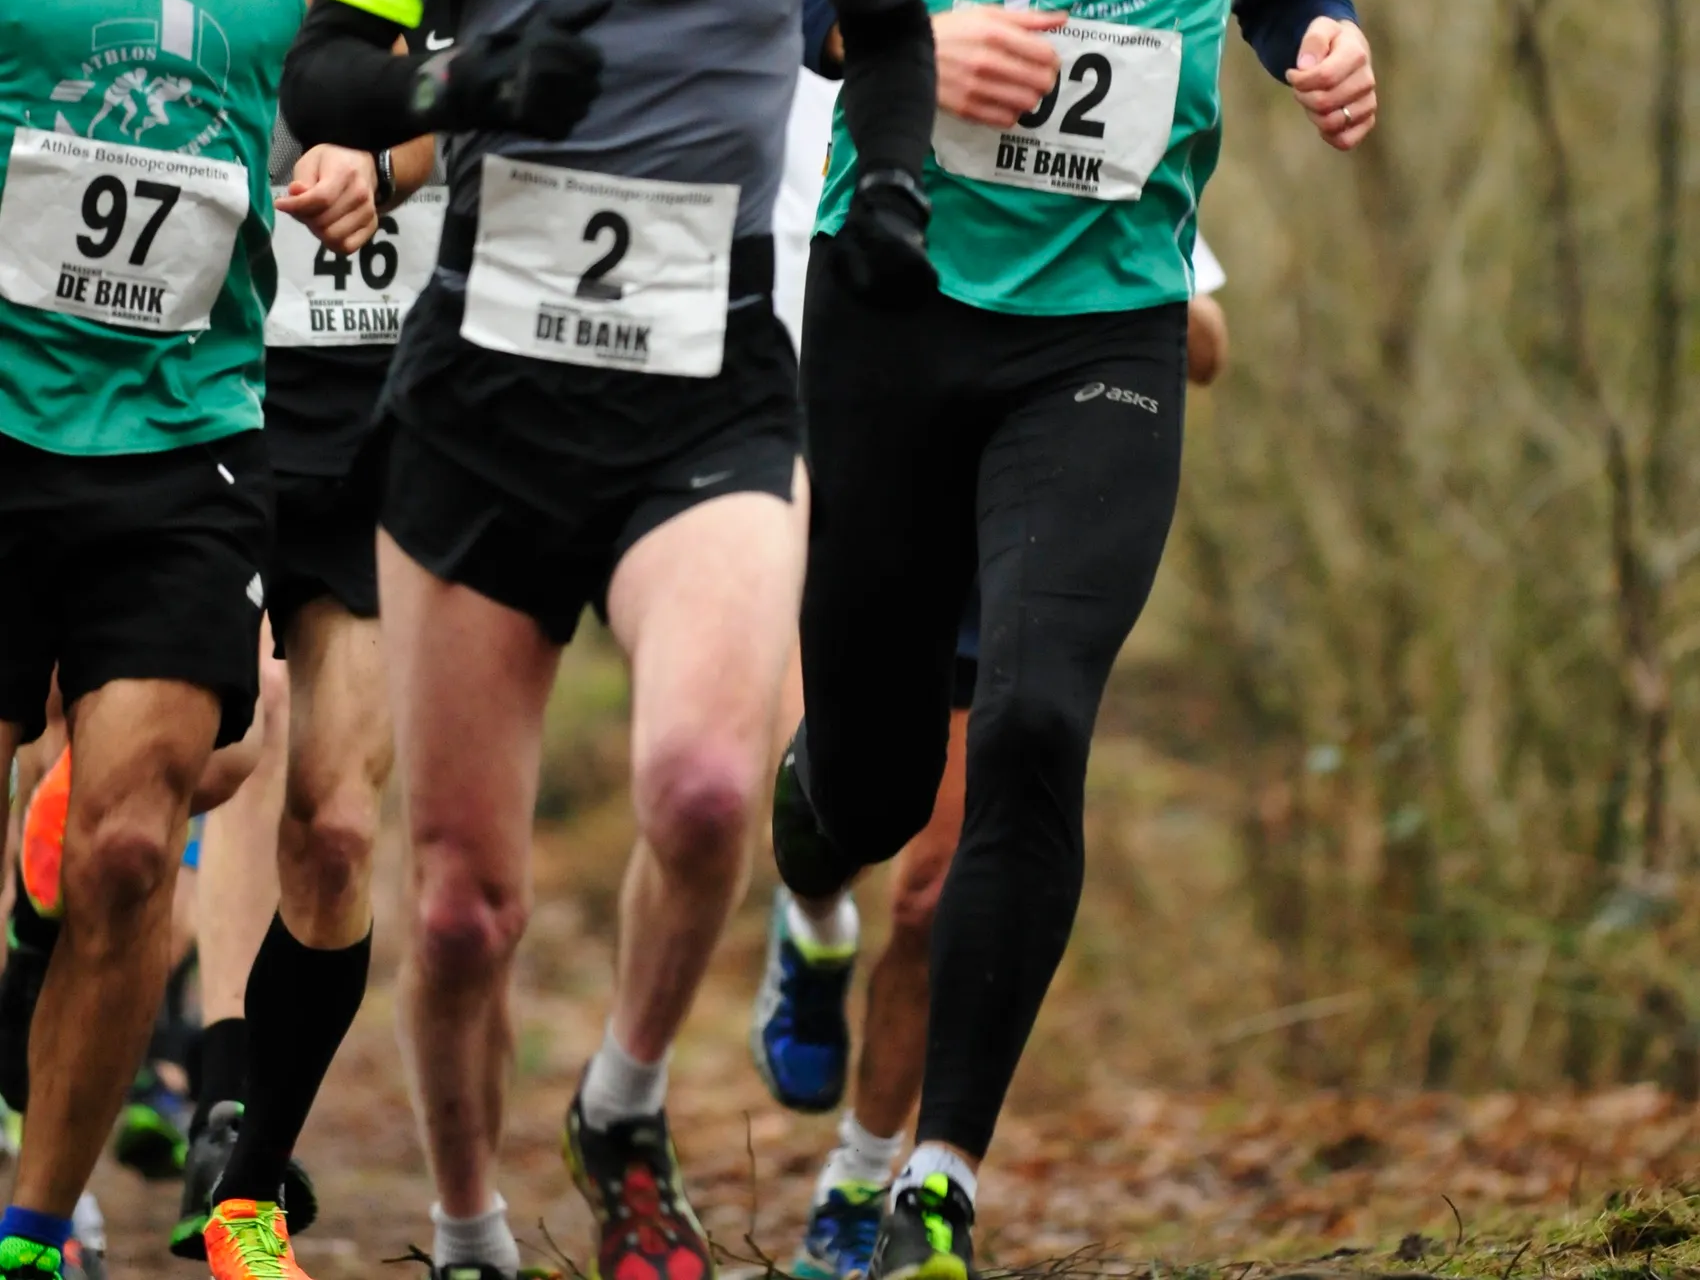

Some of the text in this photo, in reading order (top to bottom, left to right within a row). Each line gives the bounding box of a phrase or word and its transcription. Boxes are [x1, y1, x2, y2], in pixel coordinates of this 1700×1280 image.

[1045, 25, 1163, 50] sloopcompetitie
[81, 46, 157, 75] ATHLOS
[40, 138, 229, 182] Athlos Bosloopcompetitie
[996, 143, 1103, 182] DE BANK
[76, 174, 181, 266] 97
[313, 215, 399, 291] 46
[574, 209, 630, 302] 2
[56, 272, 165, 314] DE BANK
[310, 308, 399, 332] DE BANK
[536, 313, 650, 352] DE BANK
[1106, 387, 1159, 414] asics
